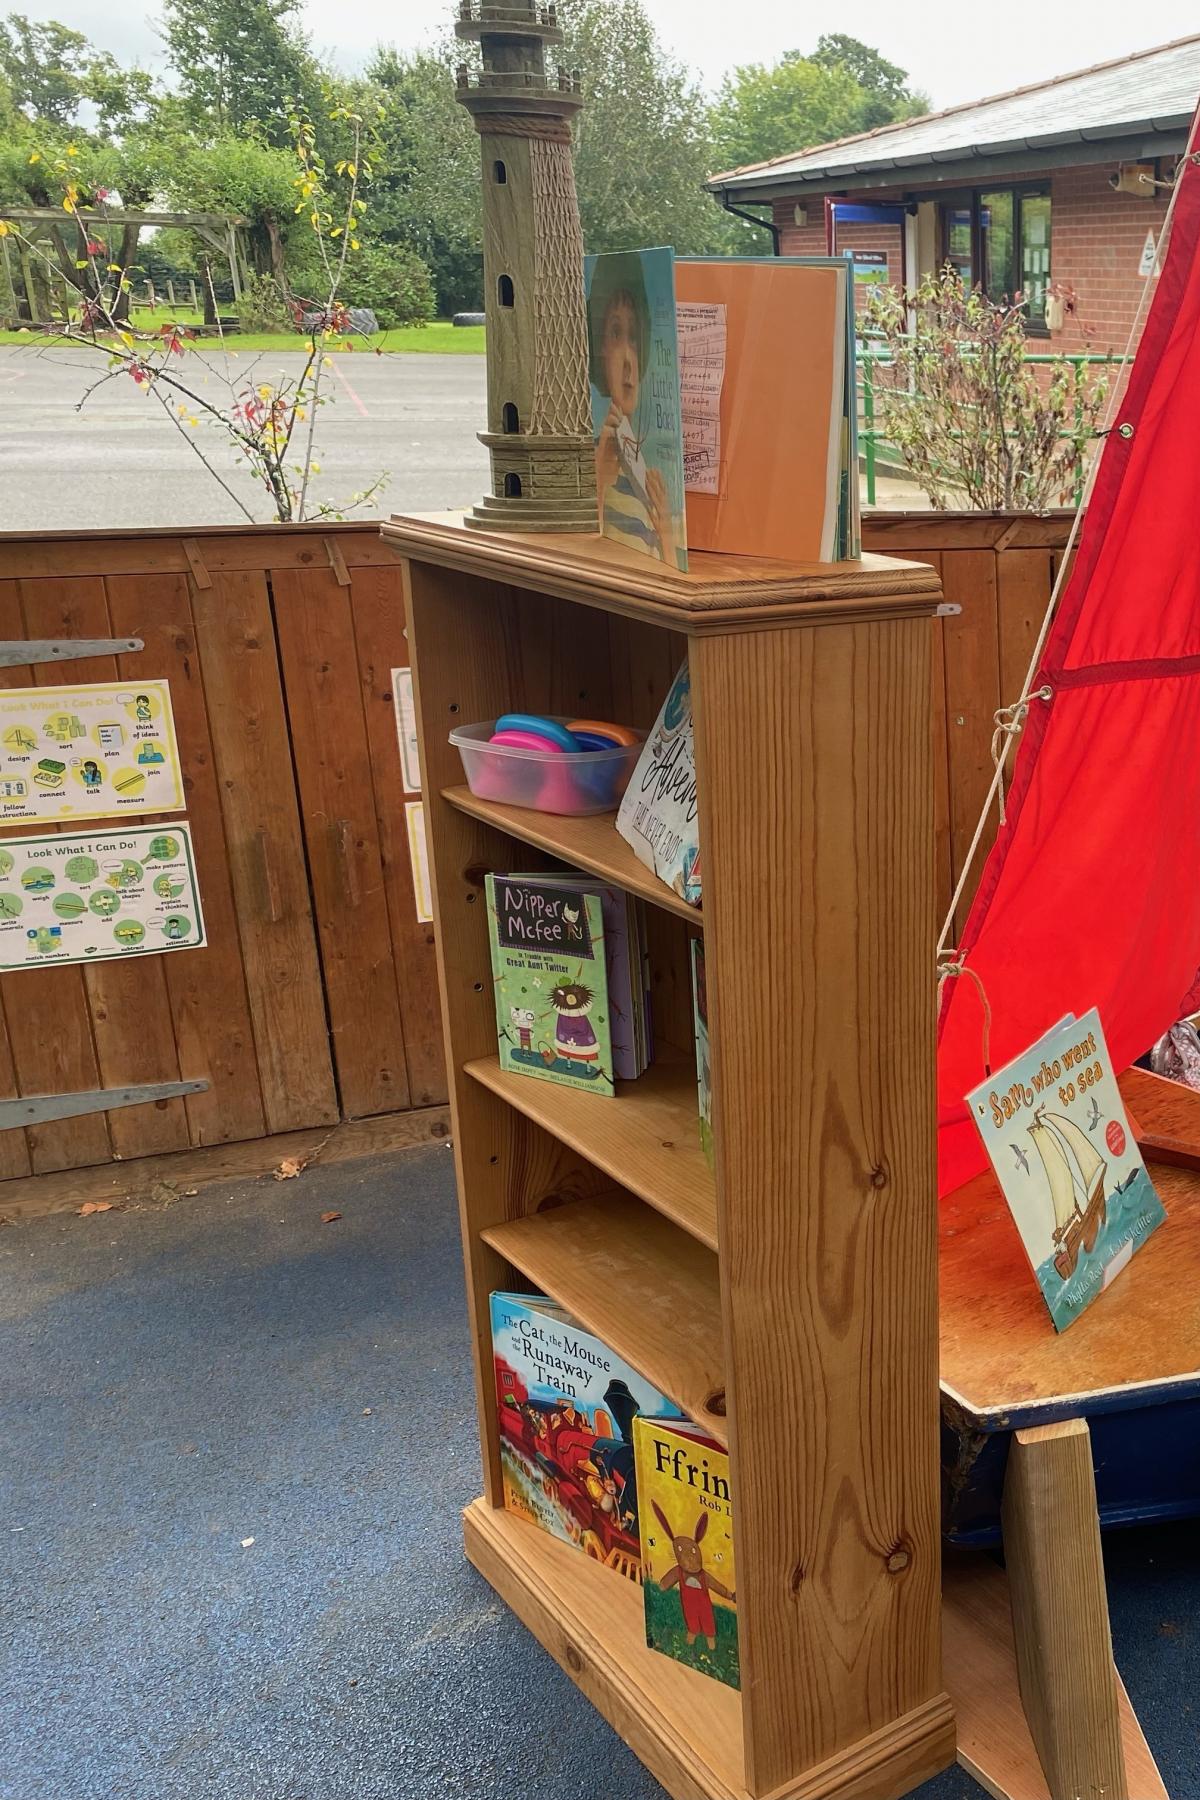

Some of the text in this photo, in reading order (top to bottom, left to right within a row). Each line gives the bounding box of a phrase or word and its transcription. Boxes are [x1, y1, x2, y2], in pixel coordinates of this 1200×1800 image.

[655, 339, 671, 366] The
[651, 371, 673, 400] Little
[4, 804, 26, 812] follow
[632, 801, 684, 865] THAT NEVER ENDS
[27, 841, 137, 859] Look What I Can Do!
[504, 886, 561, 918] Nipper
[506, 957, 569, 974] Great Aunt Twitter
[989, 1031, 1097, 1128] Sam who went
[1058, 1061, 1104, 1107] to sea
[1065, 1280, 1090, 1308] Phyllis
[501, 1314, 518, 1328] The
[549, 1334, 562, 1348] the
[563, 1336, 611, 1372] Mouse
[511, 1336, 521, 1344] and
[522, 1338, 593, 1388] Runaway
[532, 1362, 577, 1398] Train
[653, 1439, 732, 1502] Ffrin
[699, 1494, 721, 1512] Rob
